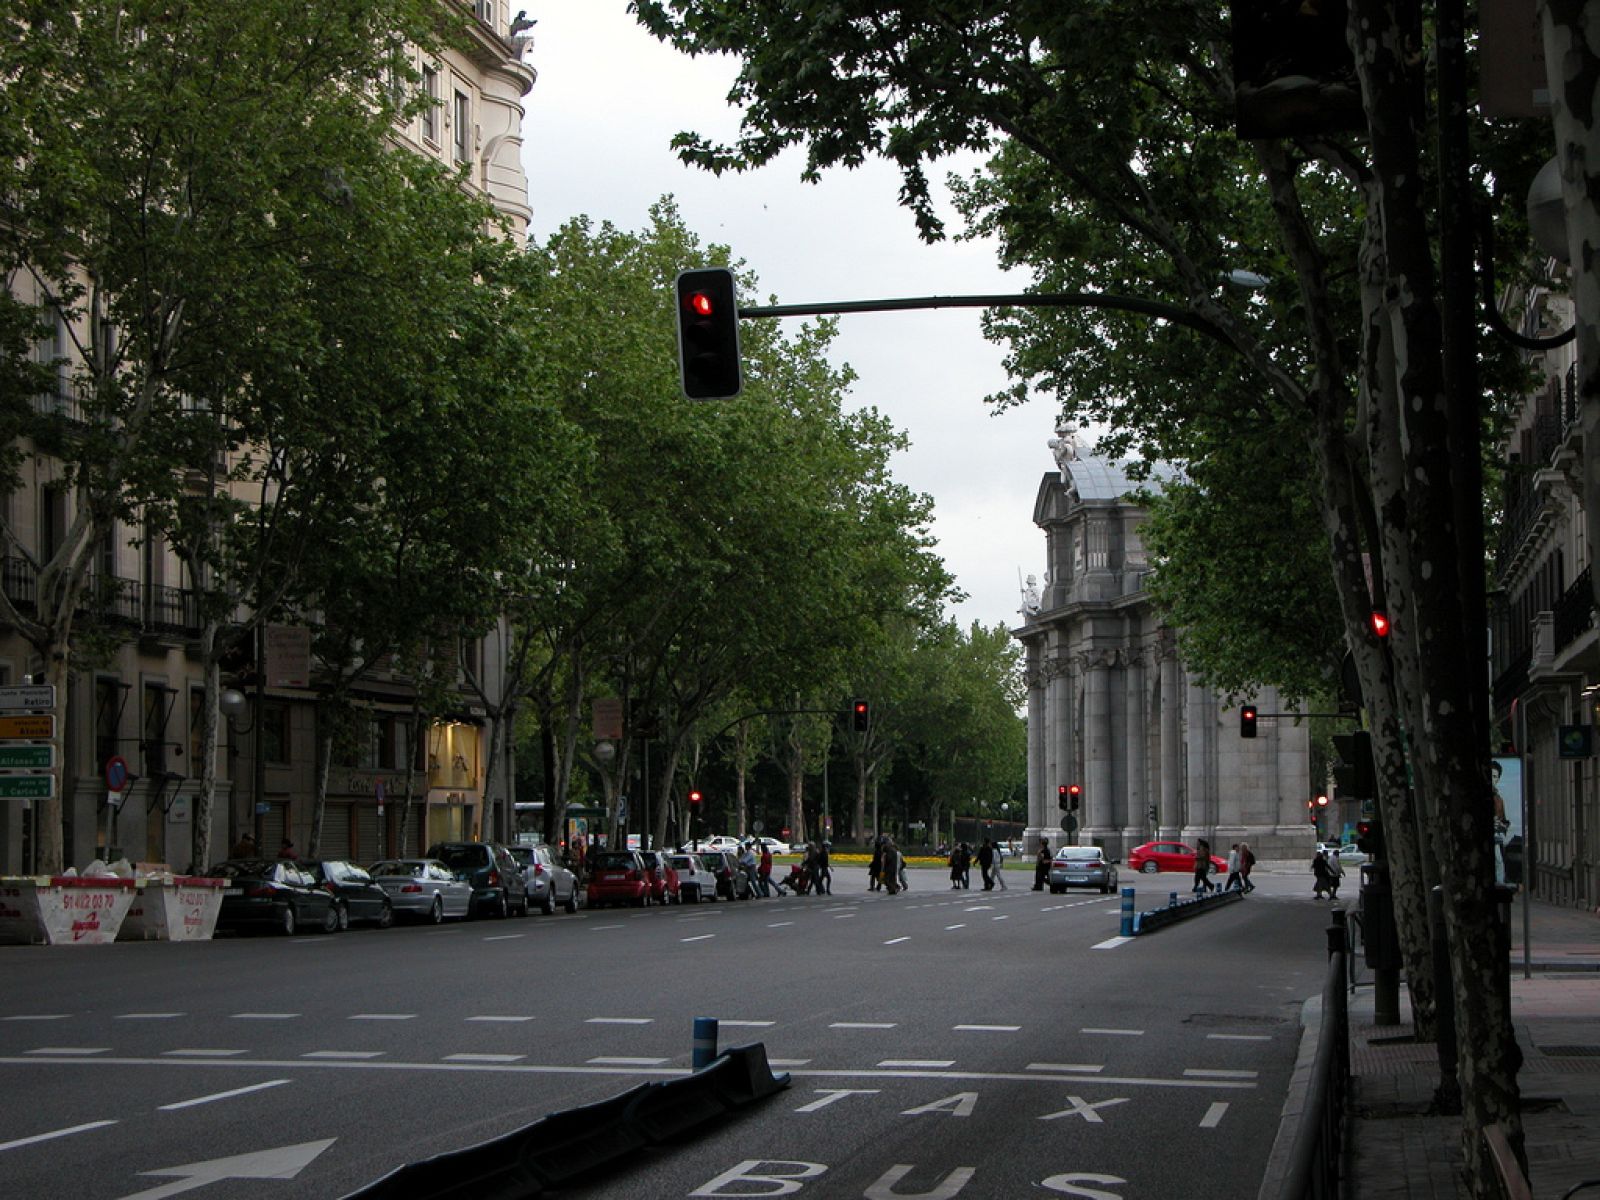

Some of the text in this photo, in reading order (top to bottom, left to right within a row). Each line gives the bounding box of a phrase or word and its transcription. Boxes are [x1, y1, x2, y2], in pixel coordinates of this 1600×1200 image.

[20, 727, 49, 735] Atocha
[0, 757, 34, 765] Alfonso
[10, 787, 39, 796] Carlos
[794, 1088, 1230, 1128] TAXI
[687, 1160, 1128, 1200] BUS
